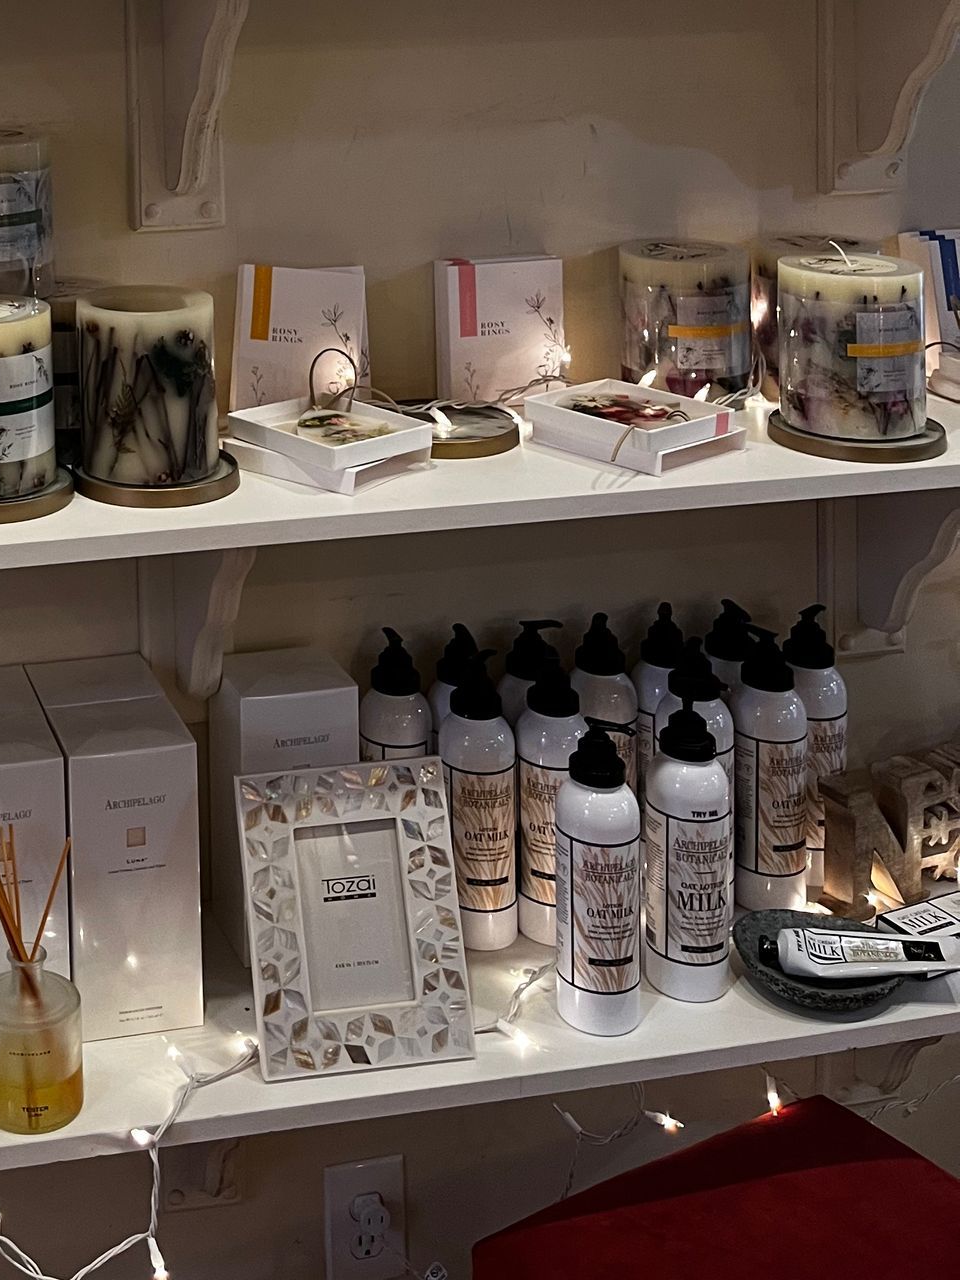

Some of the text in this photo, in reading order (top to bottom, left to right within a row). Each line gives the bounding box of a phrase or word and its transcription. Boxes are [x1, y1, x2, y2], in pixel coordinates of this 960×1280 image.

[272, 327, 298, 336] ROSY
[481, 321, 505, 329] ROSY
[271, 335, 304, 344] RINGS
[481, 329, 511, 337] RINGS
[273, 734, 330, 749] ARCHIPELAGO
[104, 795, 167, 811] ARCHIPELAGO
[529, 822, 546, 835] OAT
[464, 830, 509, 842] OAT MILK
[680, 880, 725, 891] OAT LOTION
[676, 889, 727, 912] MILK
[586, 906, 635, 920] OAT MILK
[901, 911, 948, 931] MILK
[807, 939, 841, 957] MILK
